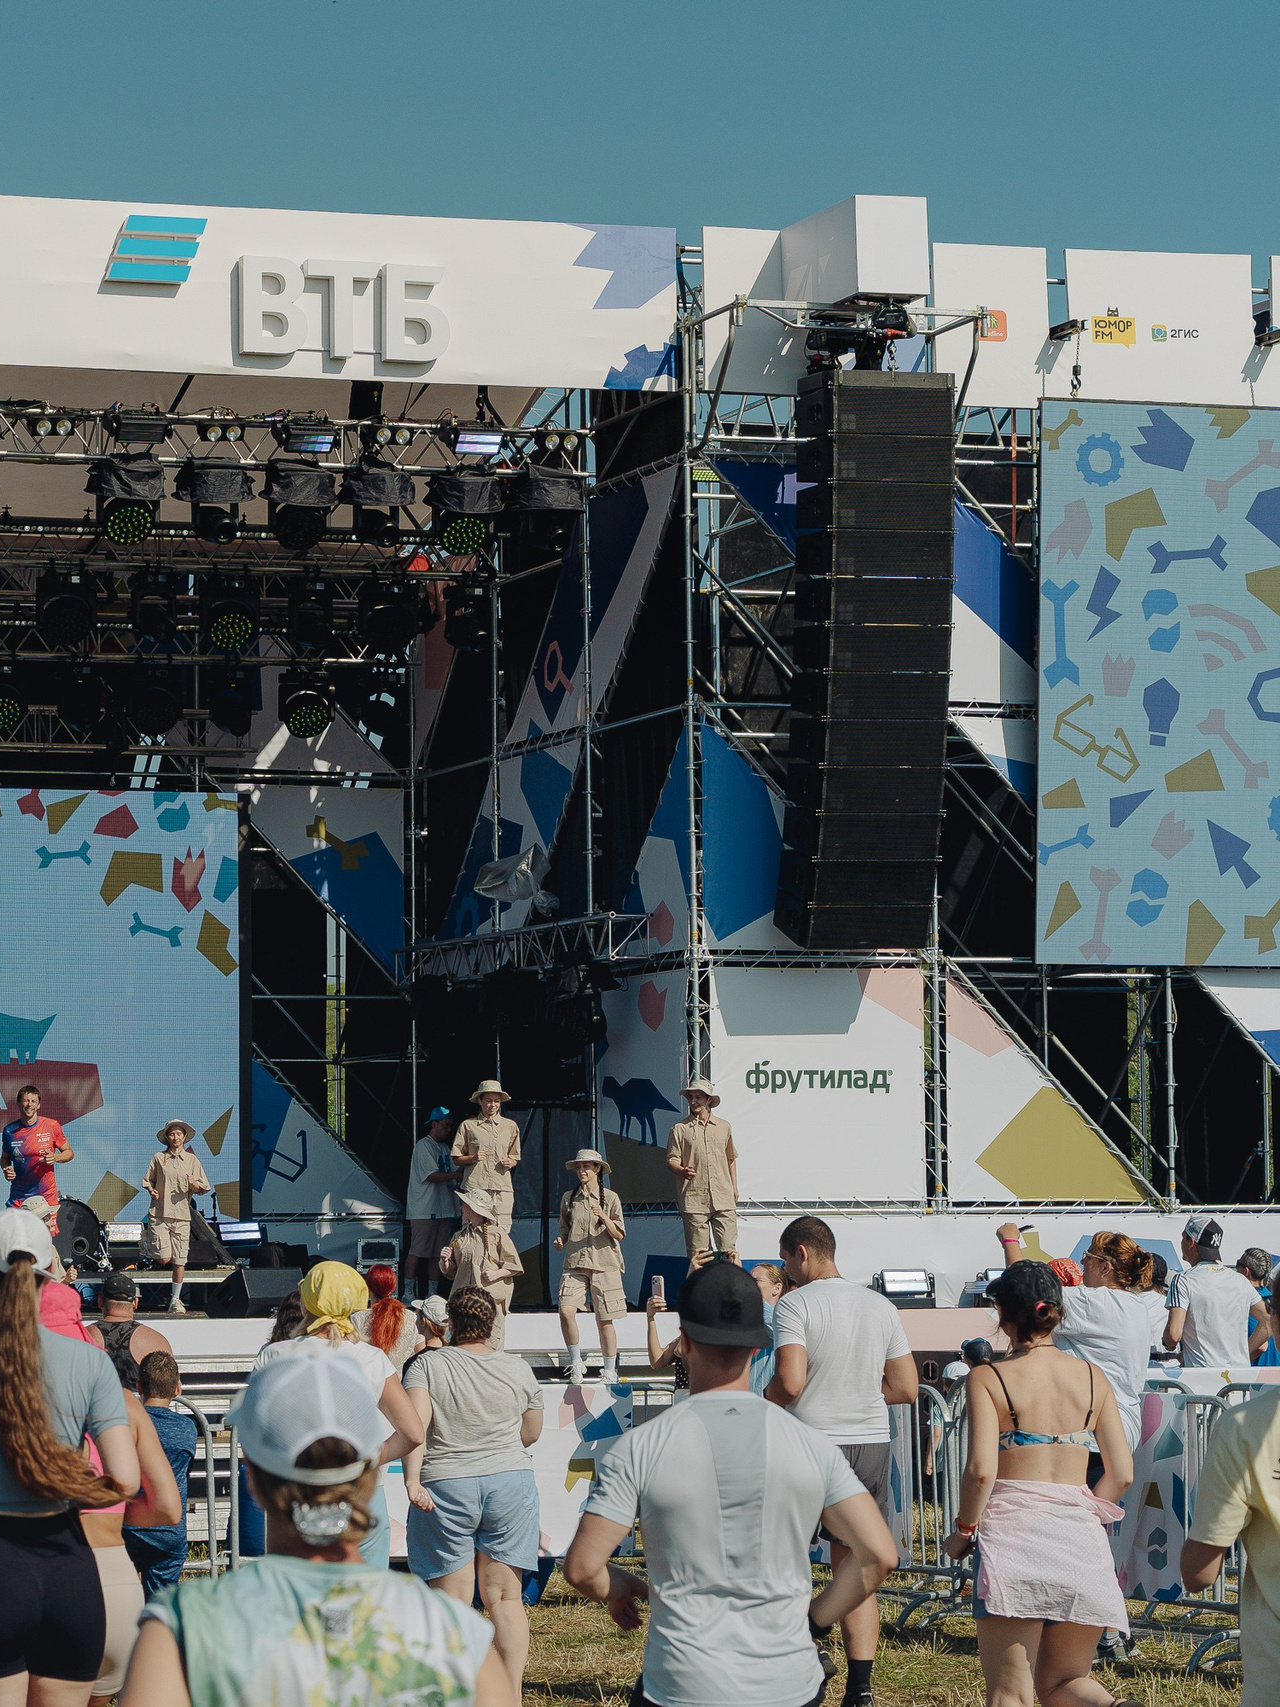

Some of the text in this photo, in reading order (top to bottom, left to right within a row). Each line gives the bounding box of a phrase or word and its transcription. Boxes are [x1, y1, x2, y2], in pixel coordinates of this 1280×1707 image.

[239, 255, 451, 362] ВТБ
[1094, 319, 1132, 333] ЮМОР
[1095, 330, 1113, 340] FM
[1170, 328, 1200, 339] 2ГИС
